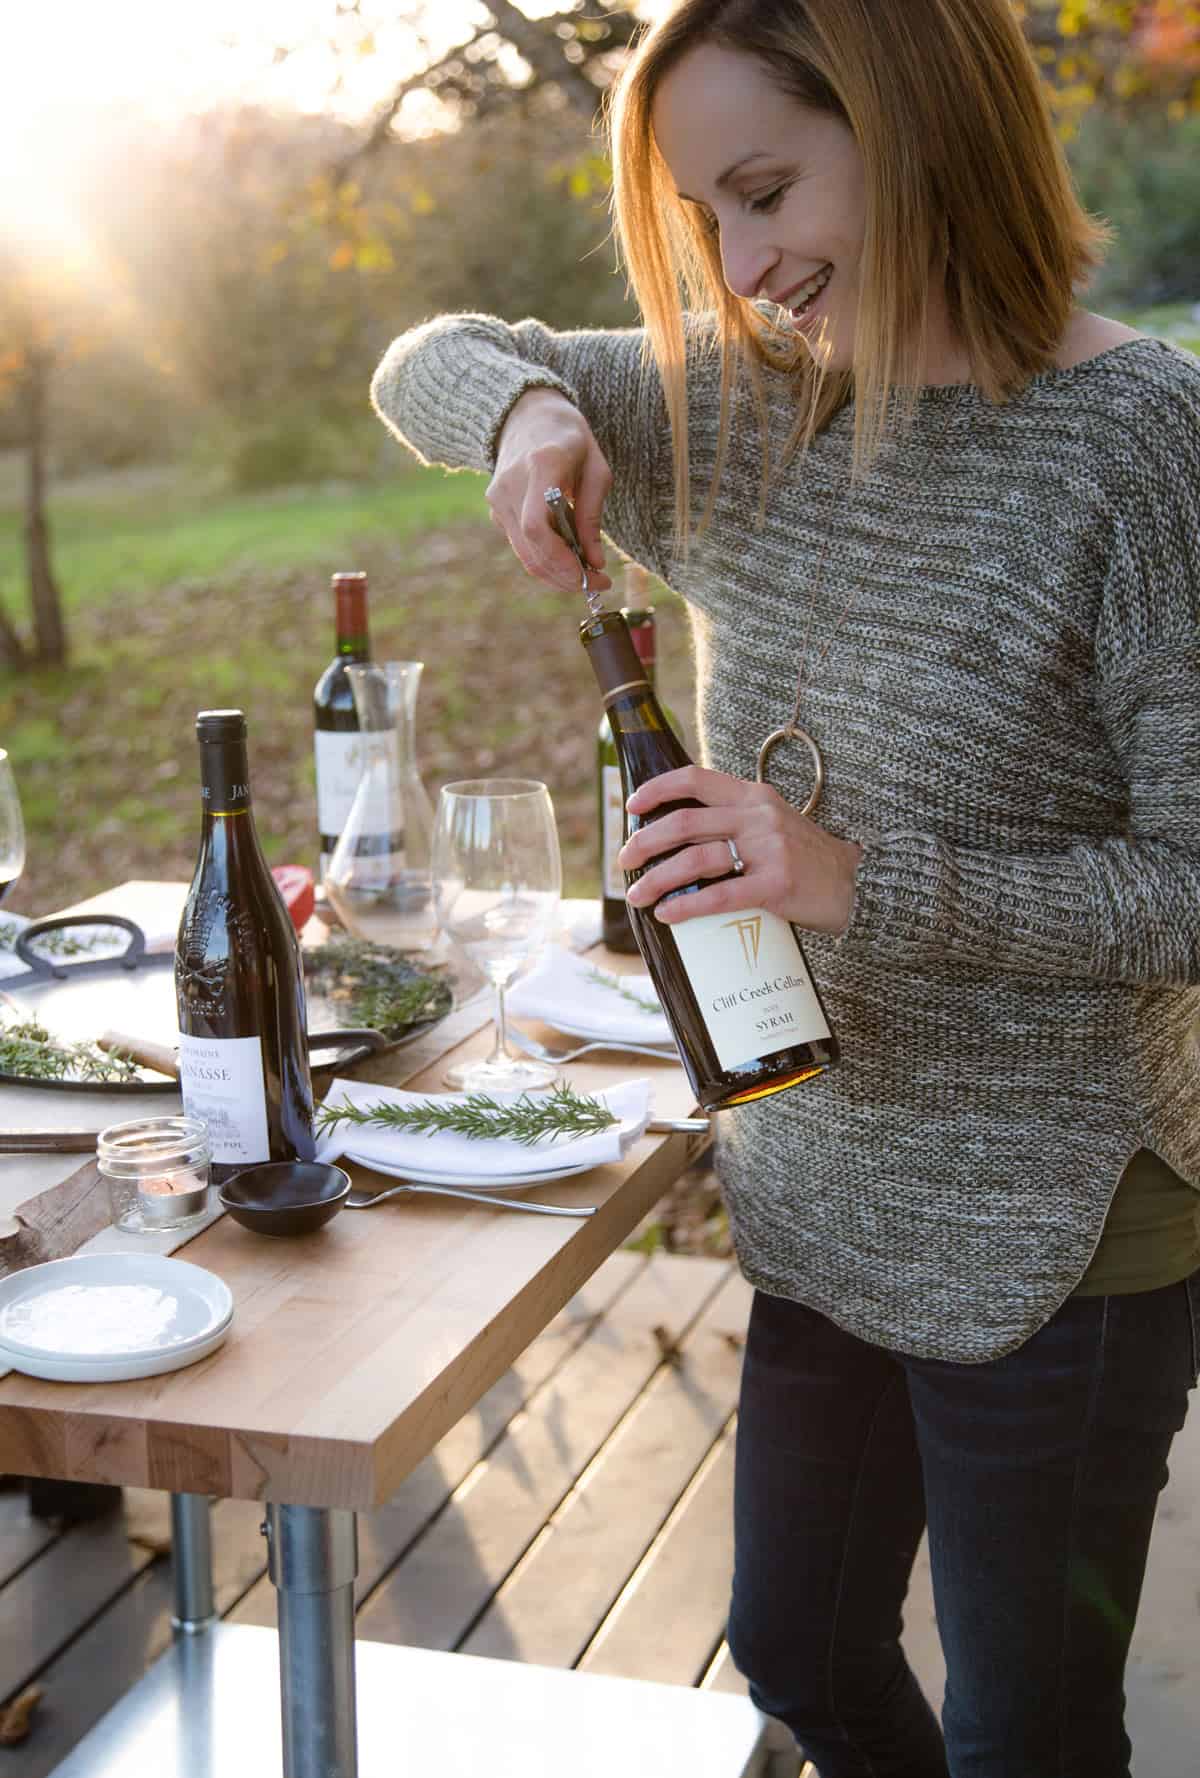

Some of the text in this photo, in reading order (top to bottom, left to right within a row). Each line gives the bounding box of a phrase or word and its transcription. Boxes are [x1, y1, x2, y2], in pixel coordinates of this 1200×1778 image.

[712, 993, 738, 1011] Cliff
[739, 981, 774, 1002] Creek
[755, 1012, 794, 1032] SYRAH
